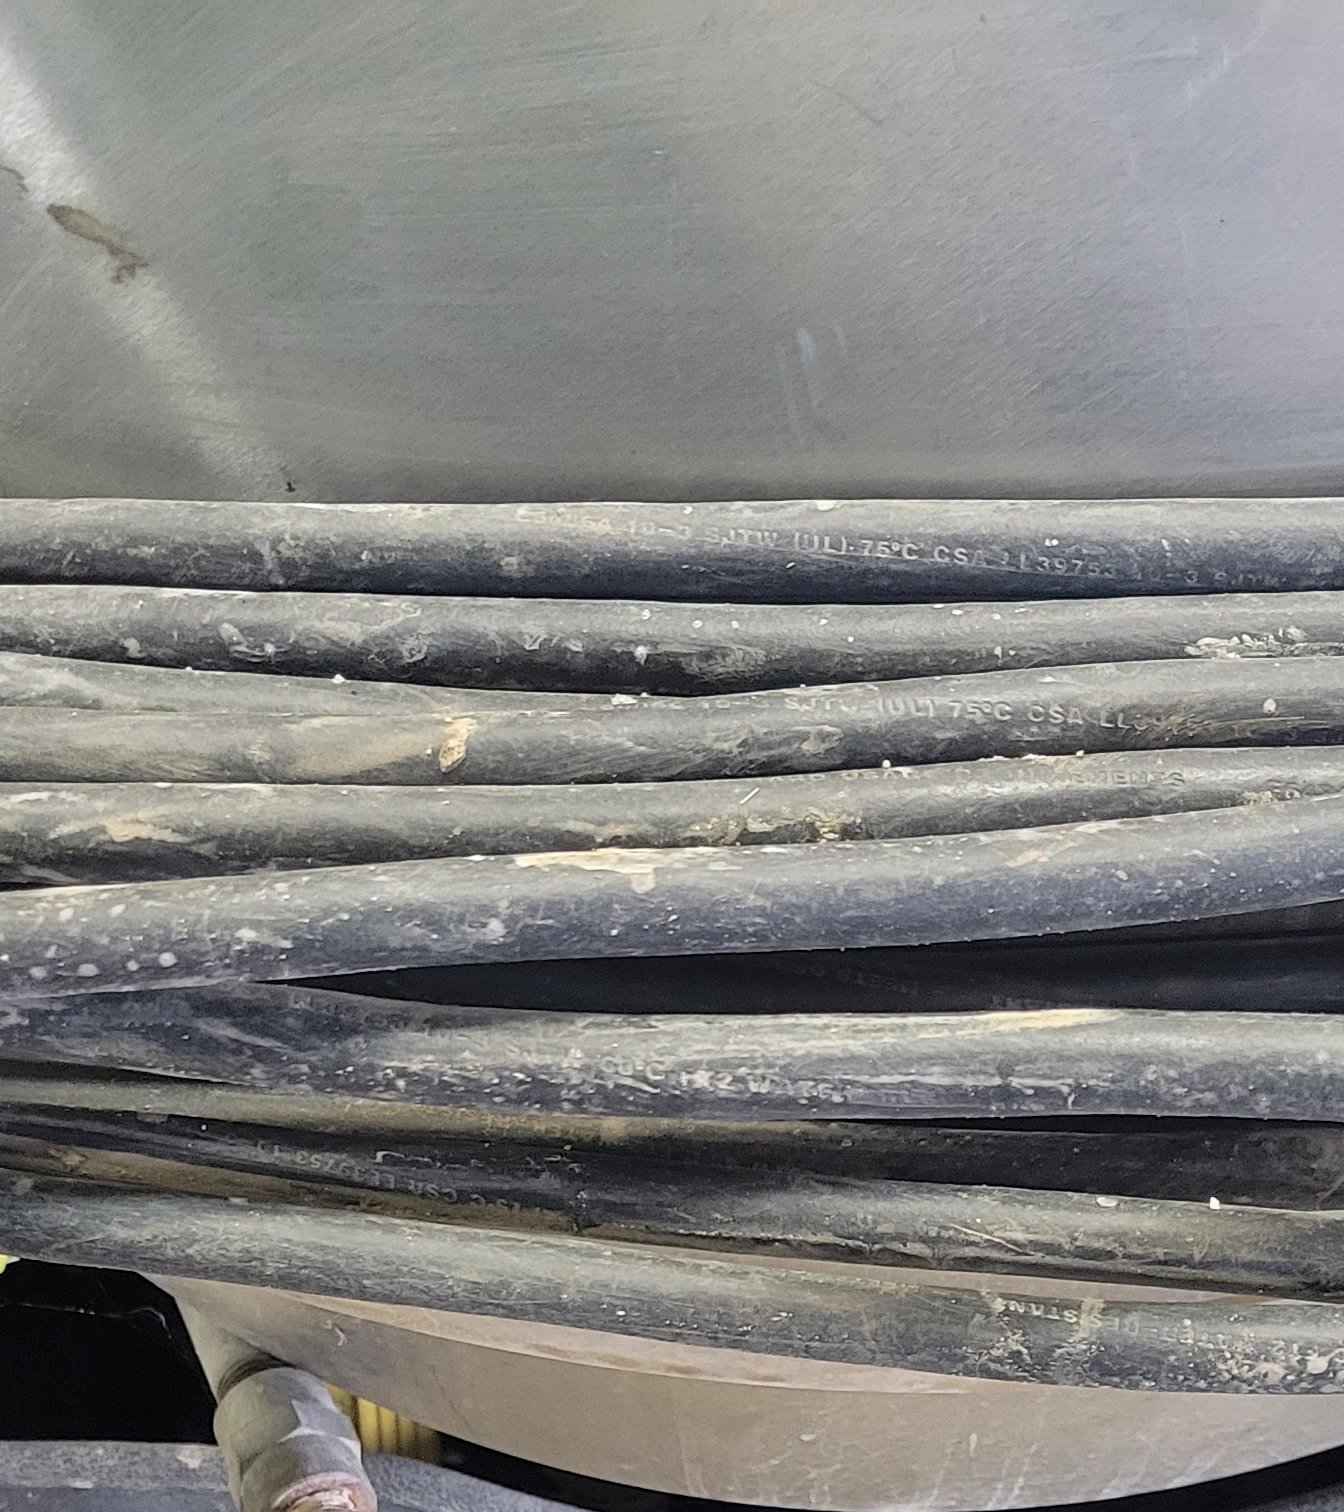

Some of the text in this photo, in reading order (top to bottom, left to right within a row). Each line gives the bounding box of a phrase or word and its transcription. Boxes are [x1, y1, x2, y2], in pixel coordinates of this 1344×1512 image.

[860, 537, 920, 561] 75°C
[933, 545, 986, 567] CSA
[1027, 703, 1084, 726] CSA
